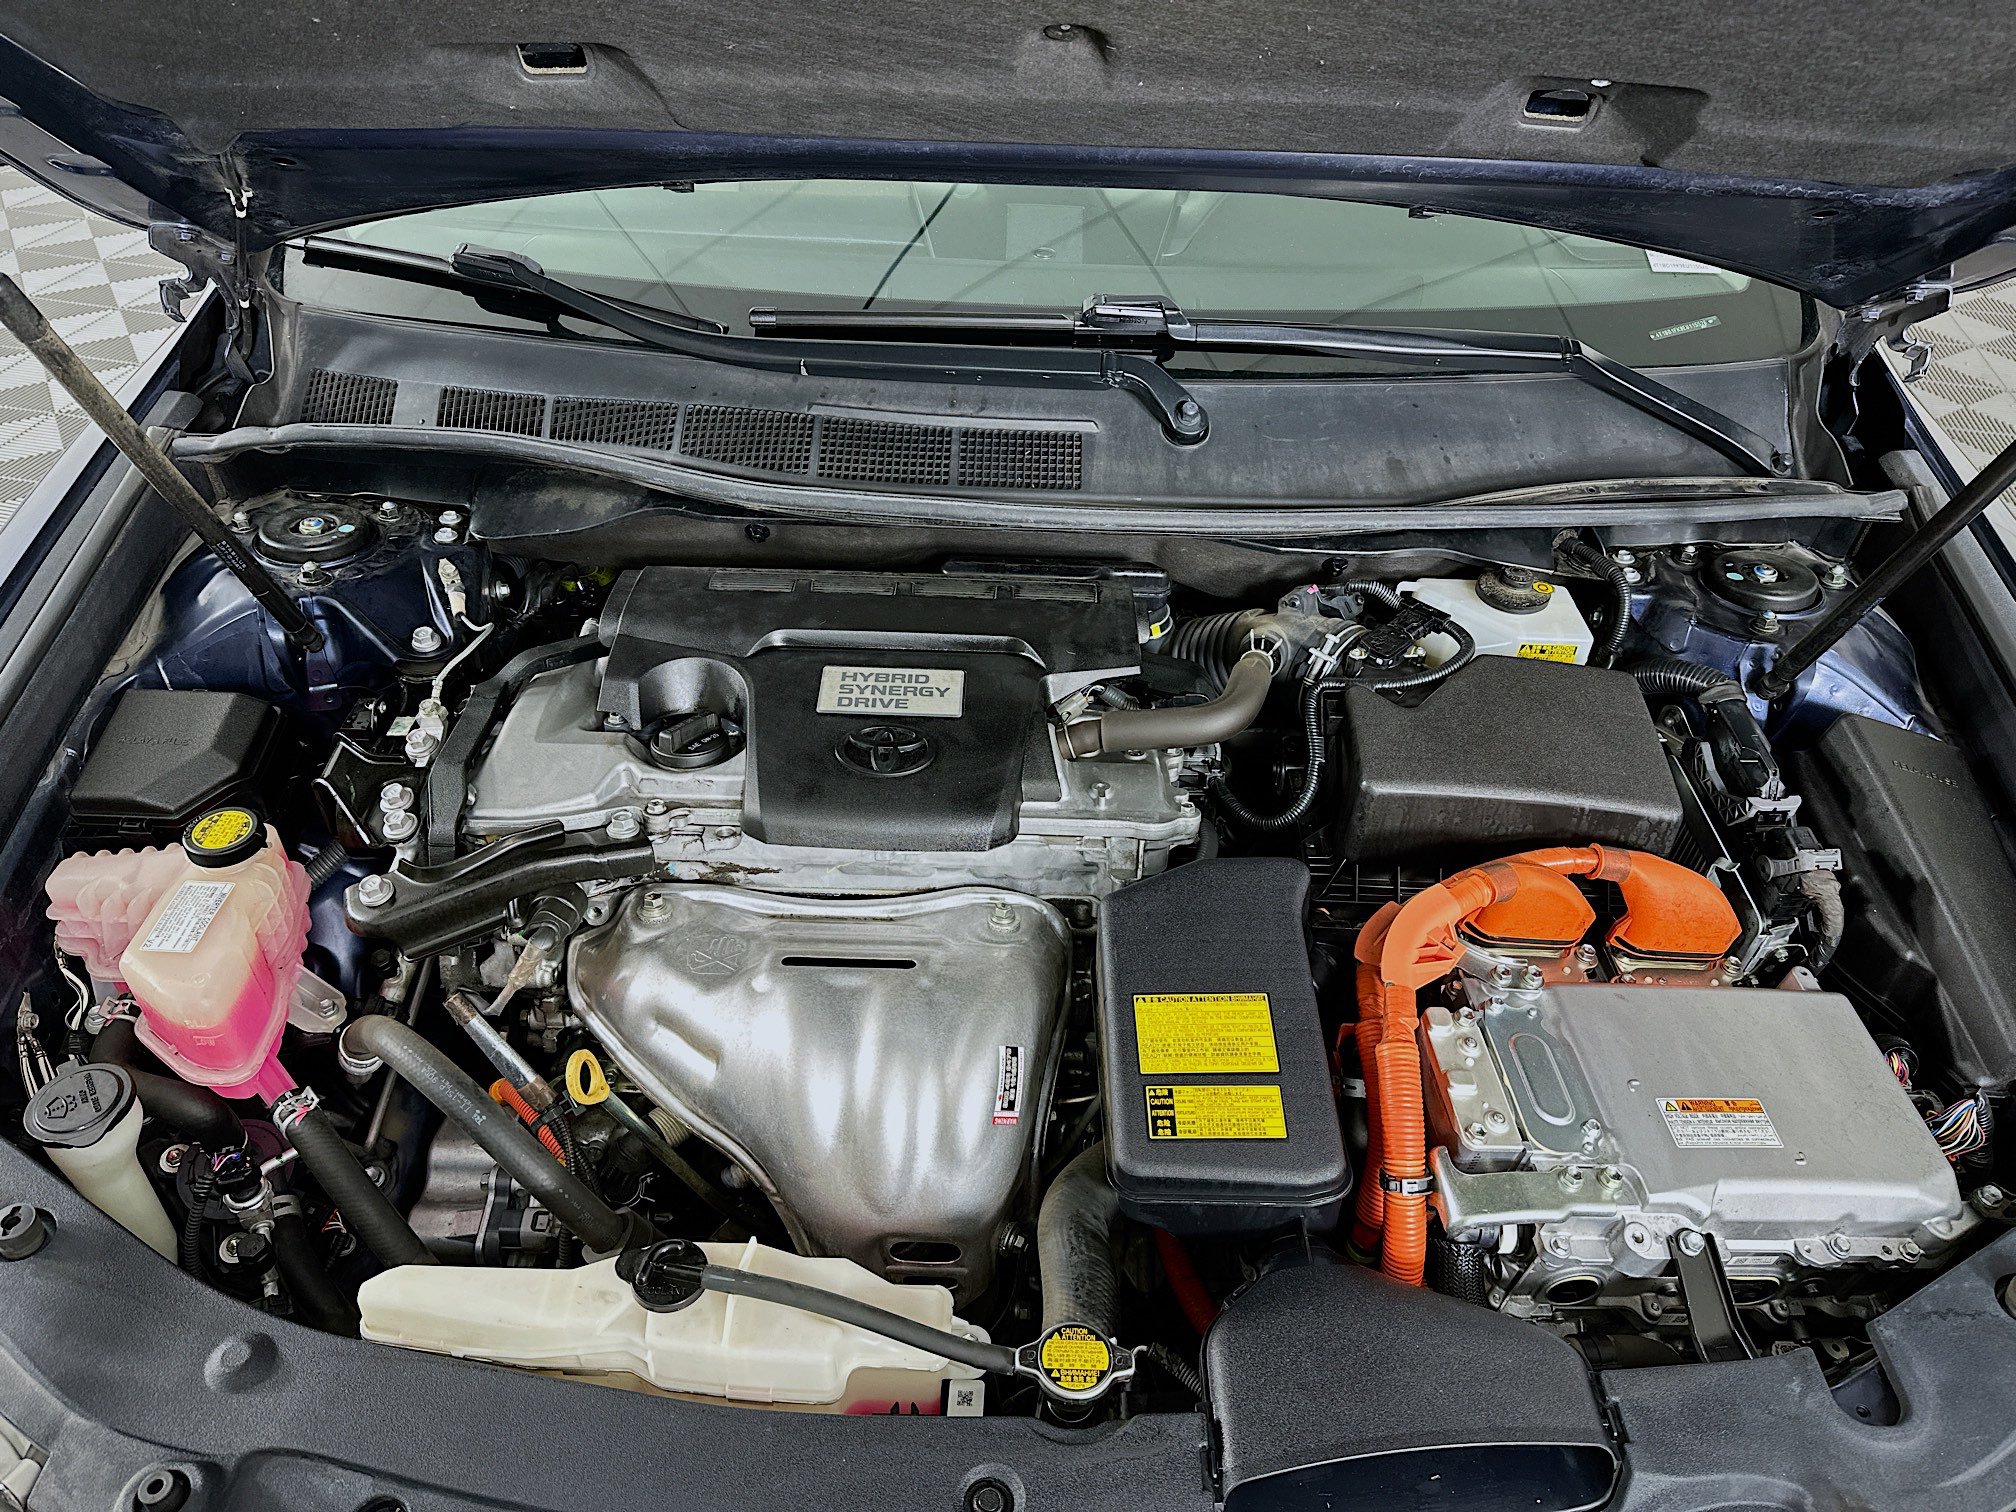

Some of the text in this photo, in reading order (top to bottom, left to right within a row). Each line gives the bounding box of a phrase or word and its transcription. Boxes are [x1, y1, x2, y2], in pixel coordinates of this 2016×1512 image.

[841, 671, 930, 684] HYBRID
[838, 684, 951, 698] SYNERGY
[837, 696, 909, 709] DRIVE
[642, 1286, 687, 1296] COOLANT
[1061, 1327, 1088, 1335] CAUTION
